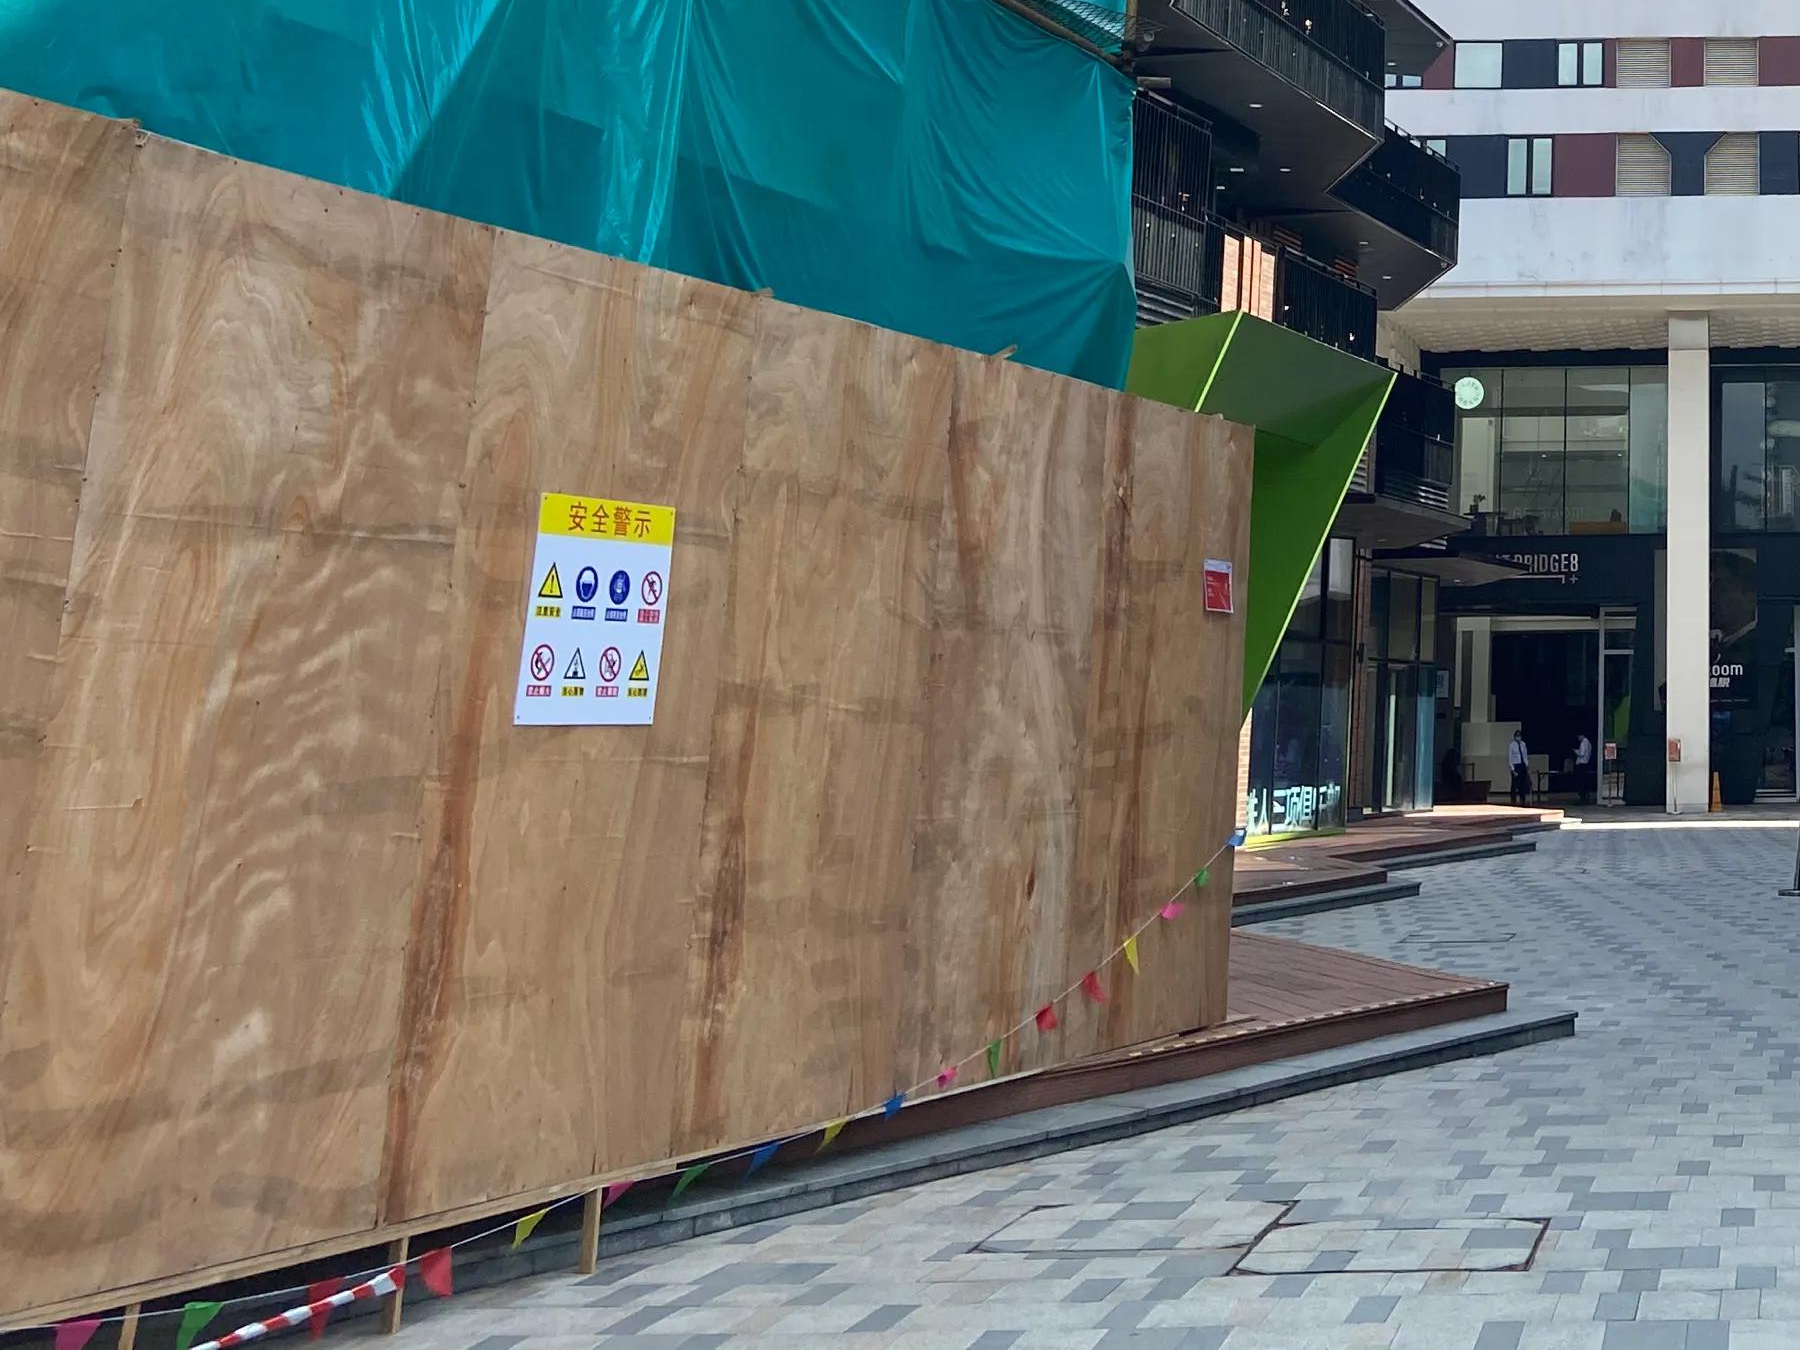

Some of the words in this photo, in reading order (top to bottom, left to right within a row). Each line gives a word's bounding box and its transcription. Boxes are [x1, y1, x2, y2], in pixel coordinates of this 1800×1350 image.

[568, 501, 652, 538] 安全警示
[1709, 664, 1743, 676] oom
